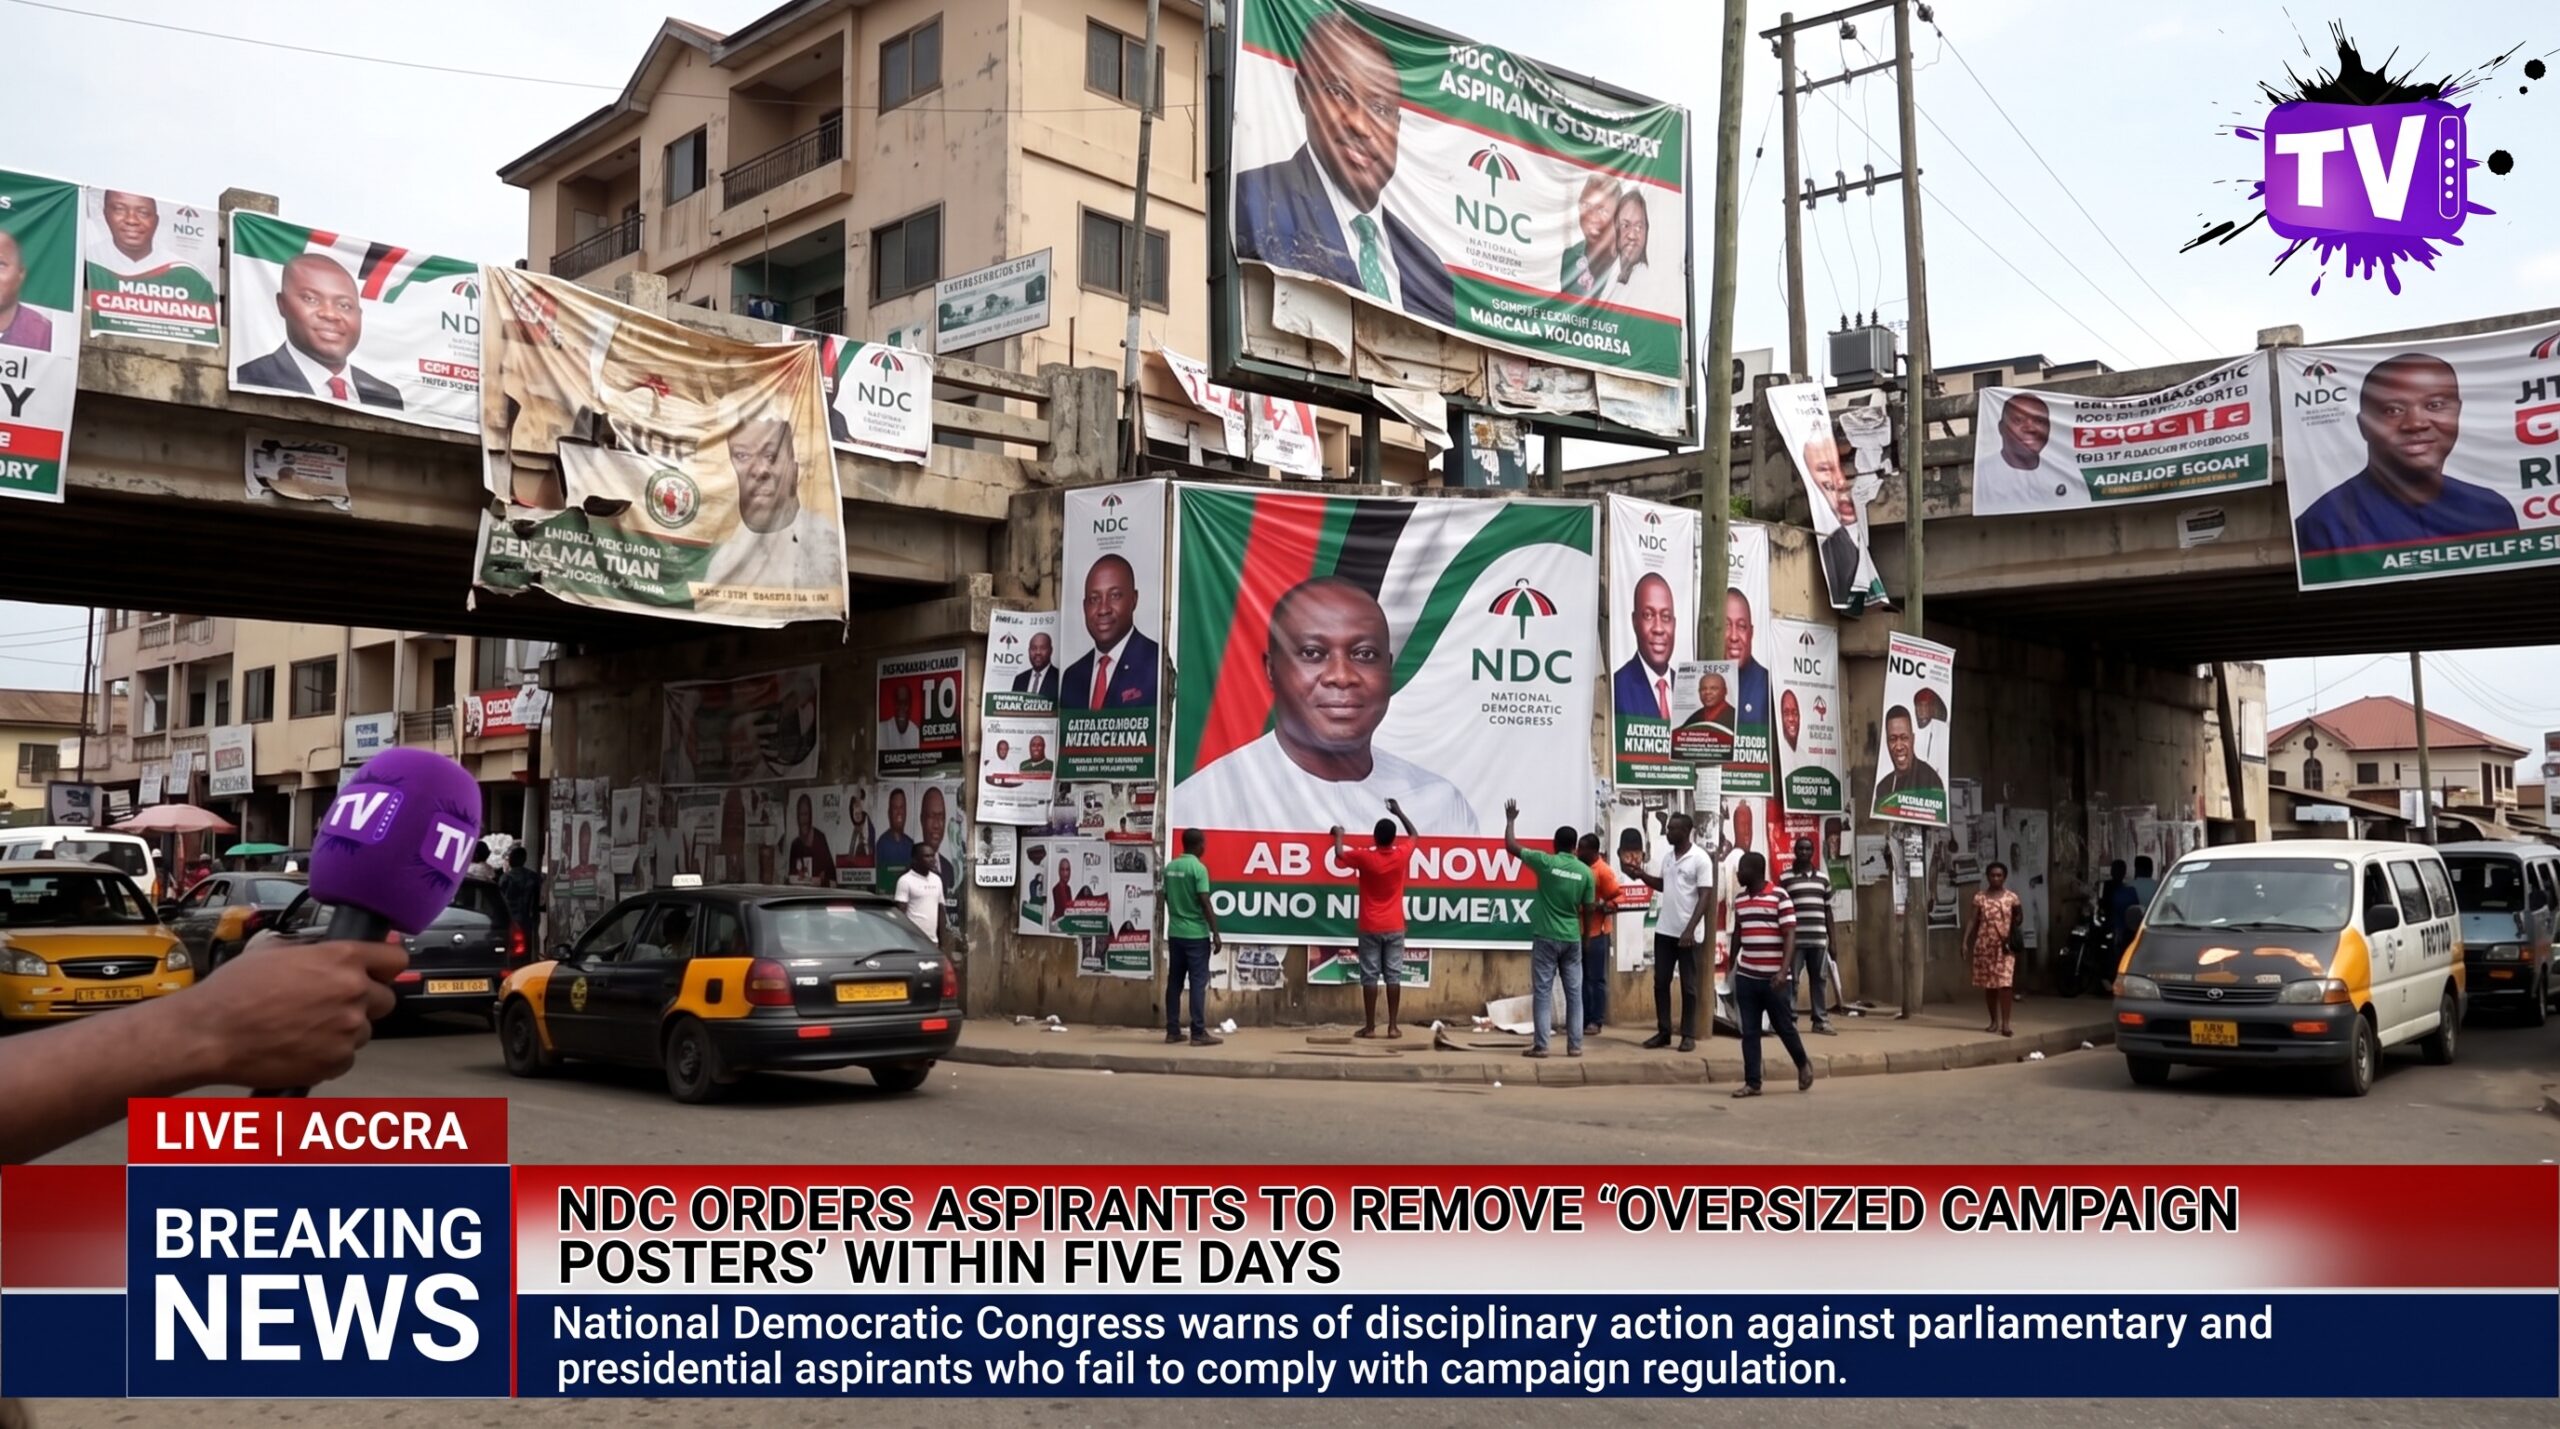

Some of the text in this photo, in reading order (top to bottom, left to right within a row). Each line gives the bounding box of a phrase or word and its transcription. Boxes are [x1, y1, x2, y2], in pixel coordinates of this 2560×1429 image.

[173, 222, 204, 238] NDC
[1456, 194, 1532, 244] NDC
[1469, 237, 1518, 256] NATIONAL
[441, 311, 480, 336] ND
[1470, 306, 1542, 338] MARCALA
[0, 356, 27, 380] al
[859, 382, 912, 412] NDC
[2295, 386, 2347, 408] NDC
[1093, 516, 1129, 534] NDC
[1638, 533, 1668, 551] NDC
[603, 553, 661, 581] TUAN
[1728, 554, 1745, 569] DC
[993, 653, 1024, 665] NDC
[1472, 647, 1573, 685] NDC
[1793, 656, 1822, 676] NDC
[1889, 654, 1927, 679] NDC
[923, 676, 957, 720] TO
[1491, 691, 1552, 703] NATIONAL
[1481, 703, 1562, 716] DEMOCRATIC
[1489, 715, 1554, 727] CONGRESS
[330, 792, 390, 831] TV
[434, 822, 475, 874] TV
[1244, 842, 1311, 877] AB
[1409, 847, 1523, 882] NOW
